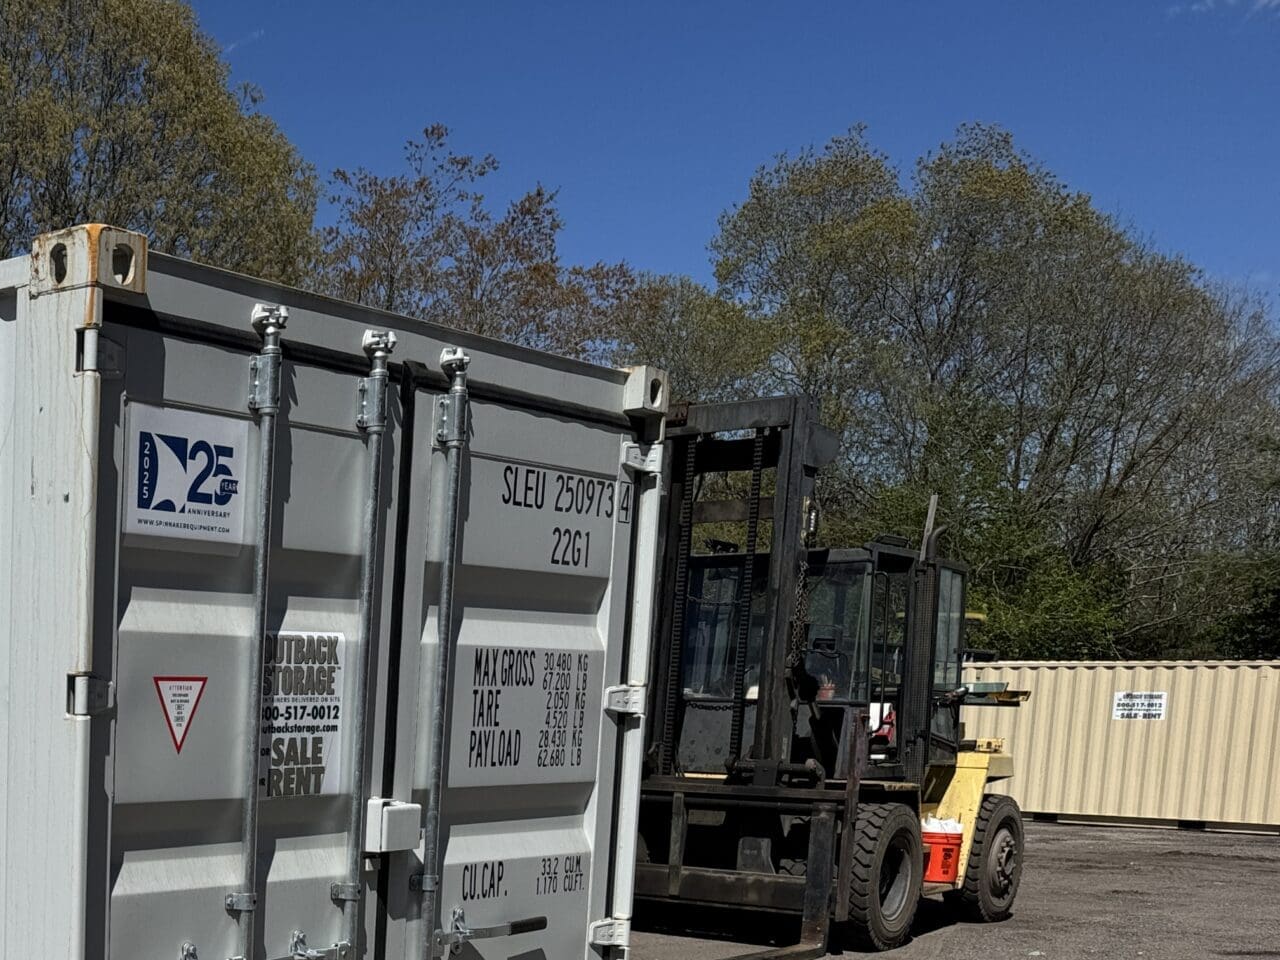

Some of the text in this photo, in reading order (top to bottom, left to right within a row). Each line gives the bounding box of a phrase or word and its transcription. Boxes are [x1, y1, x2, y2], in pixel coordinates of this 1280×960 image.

[142, 442, 151, 499] 2025
[187, 440, 234, 506] 25
[221, 482, 236, 491] YEAR
[502, 465, 631, 521] SLEU 250973 4
[187, 508, 231, 518] ANNIVERSARY
[551, 527, 591, 568] 22G1
[264, 635, 339, 665] OUTBACK
[473, 648, 589, 687] MAX GROSS 30.480 KG
[542, 672, 588, 691] 67.200 LB
[473, 689, 586, 727] TARE 2.050 KG
[545, 711, 584, 729] 4.520 LB
[262, 722, 338, 735] utbackstorage.com
[271, 737, 322, 766] SALE
[468, 729, 582, 768] PAYLOAD 28.430 KG
[537, 748, 581, 767] 62.680 LB
[267, 766, 325, 797] RENT
[462, 861, 508, 901] CU.CAP.
[541, 857, 559, 876] 33.2
[536, 876, 558, 895] 1.170
